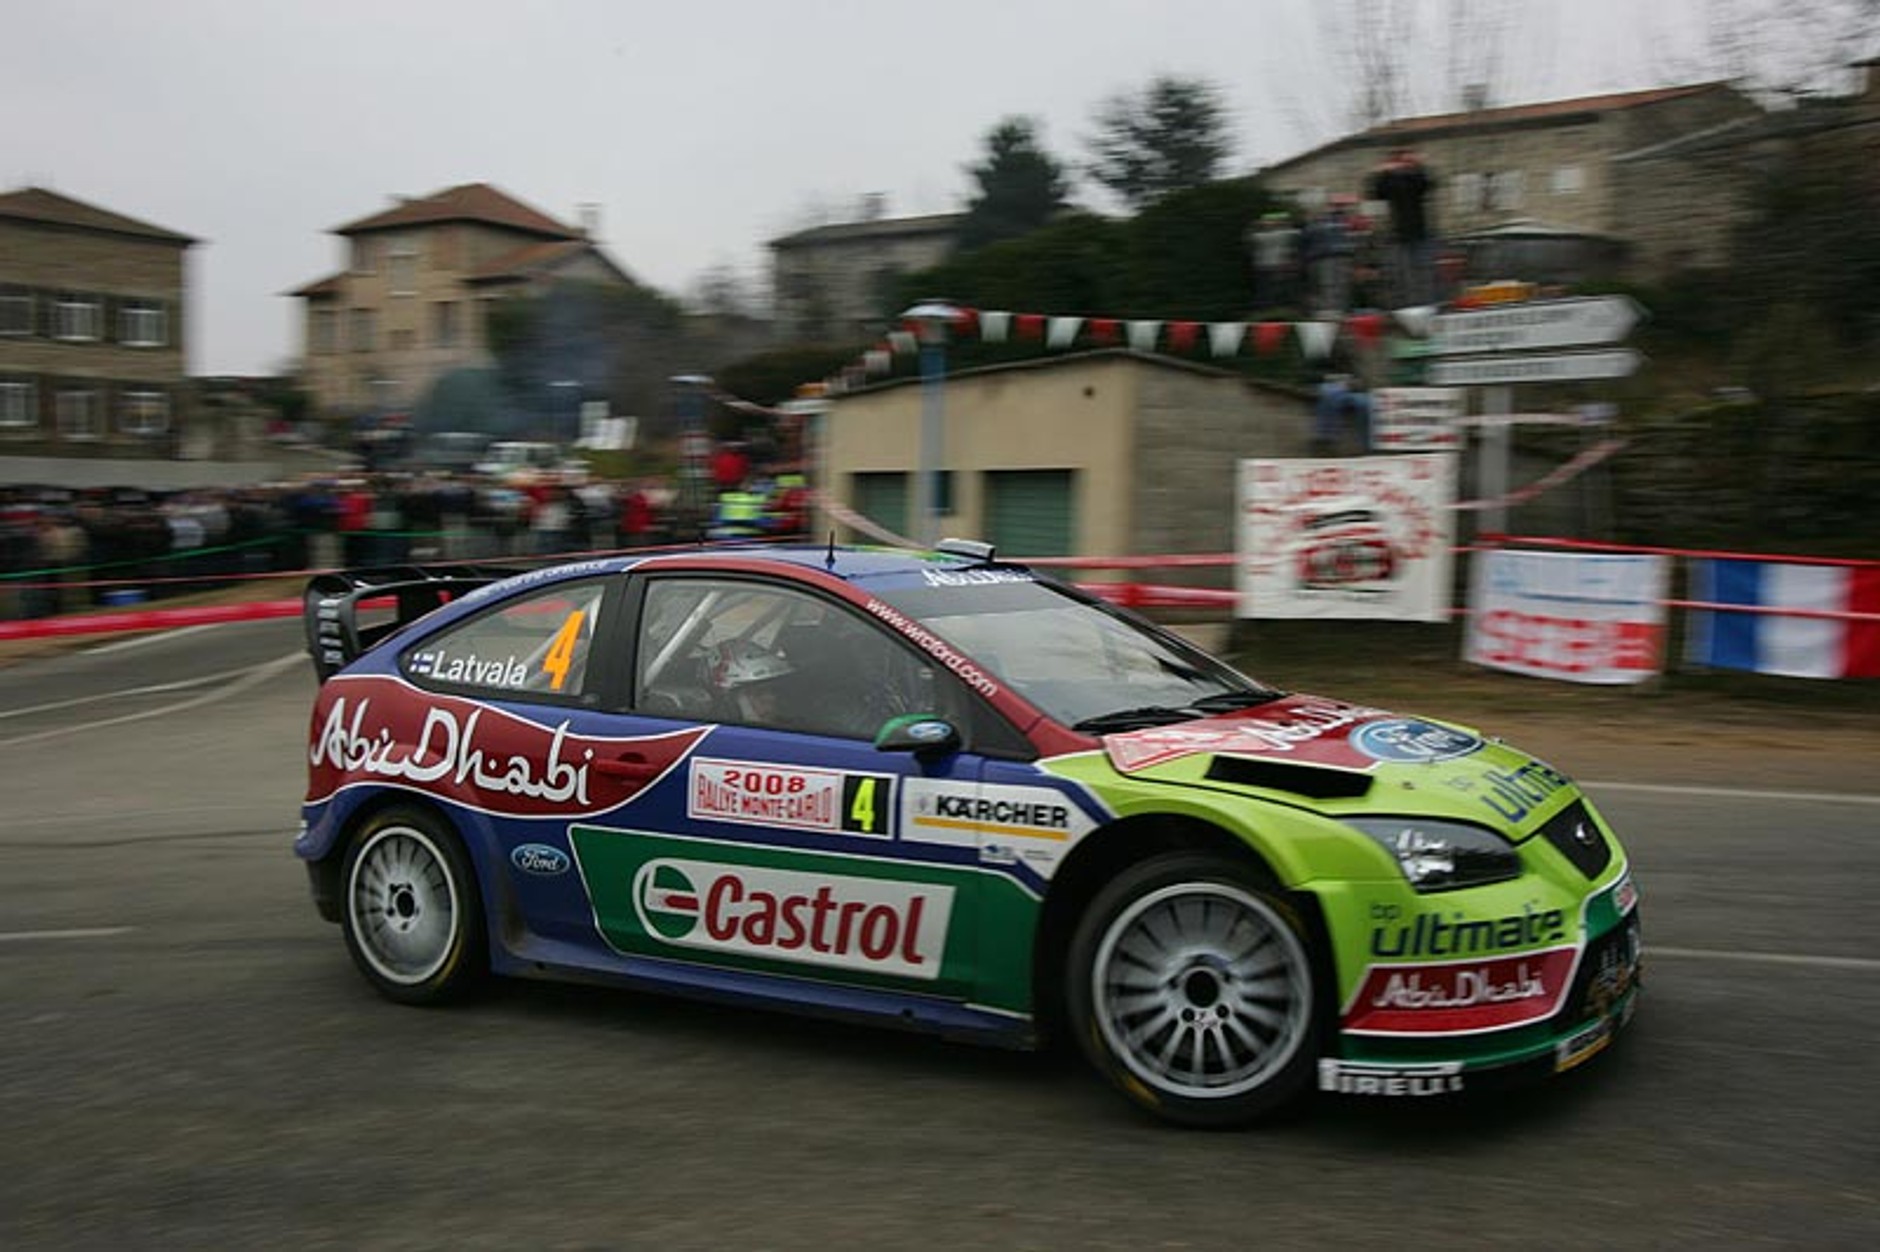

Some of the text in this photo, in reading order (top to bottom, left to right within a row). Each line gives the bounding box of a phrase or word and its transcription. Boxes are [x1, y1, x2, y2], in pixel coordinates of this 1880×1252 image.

[430, 650, 528, 687] Latvala
[543, 610, 585, 691] 4
[310, 697, 594, 806] Abu Dhabi
[697, 772, 738, 814] RALLYE
[722, 770, 806, 796] 2008
[850, 777, 876, 832] 4
[520, 849, 560, 870] Ford
[705, 874, 926, 965] Castrol
[1372, 905, 1566, 956] ultimate
[1373, 962, 1547, 1008] Abu Dhabi
